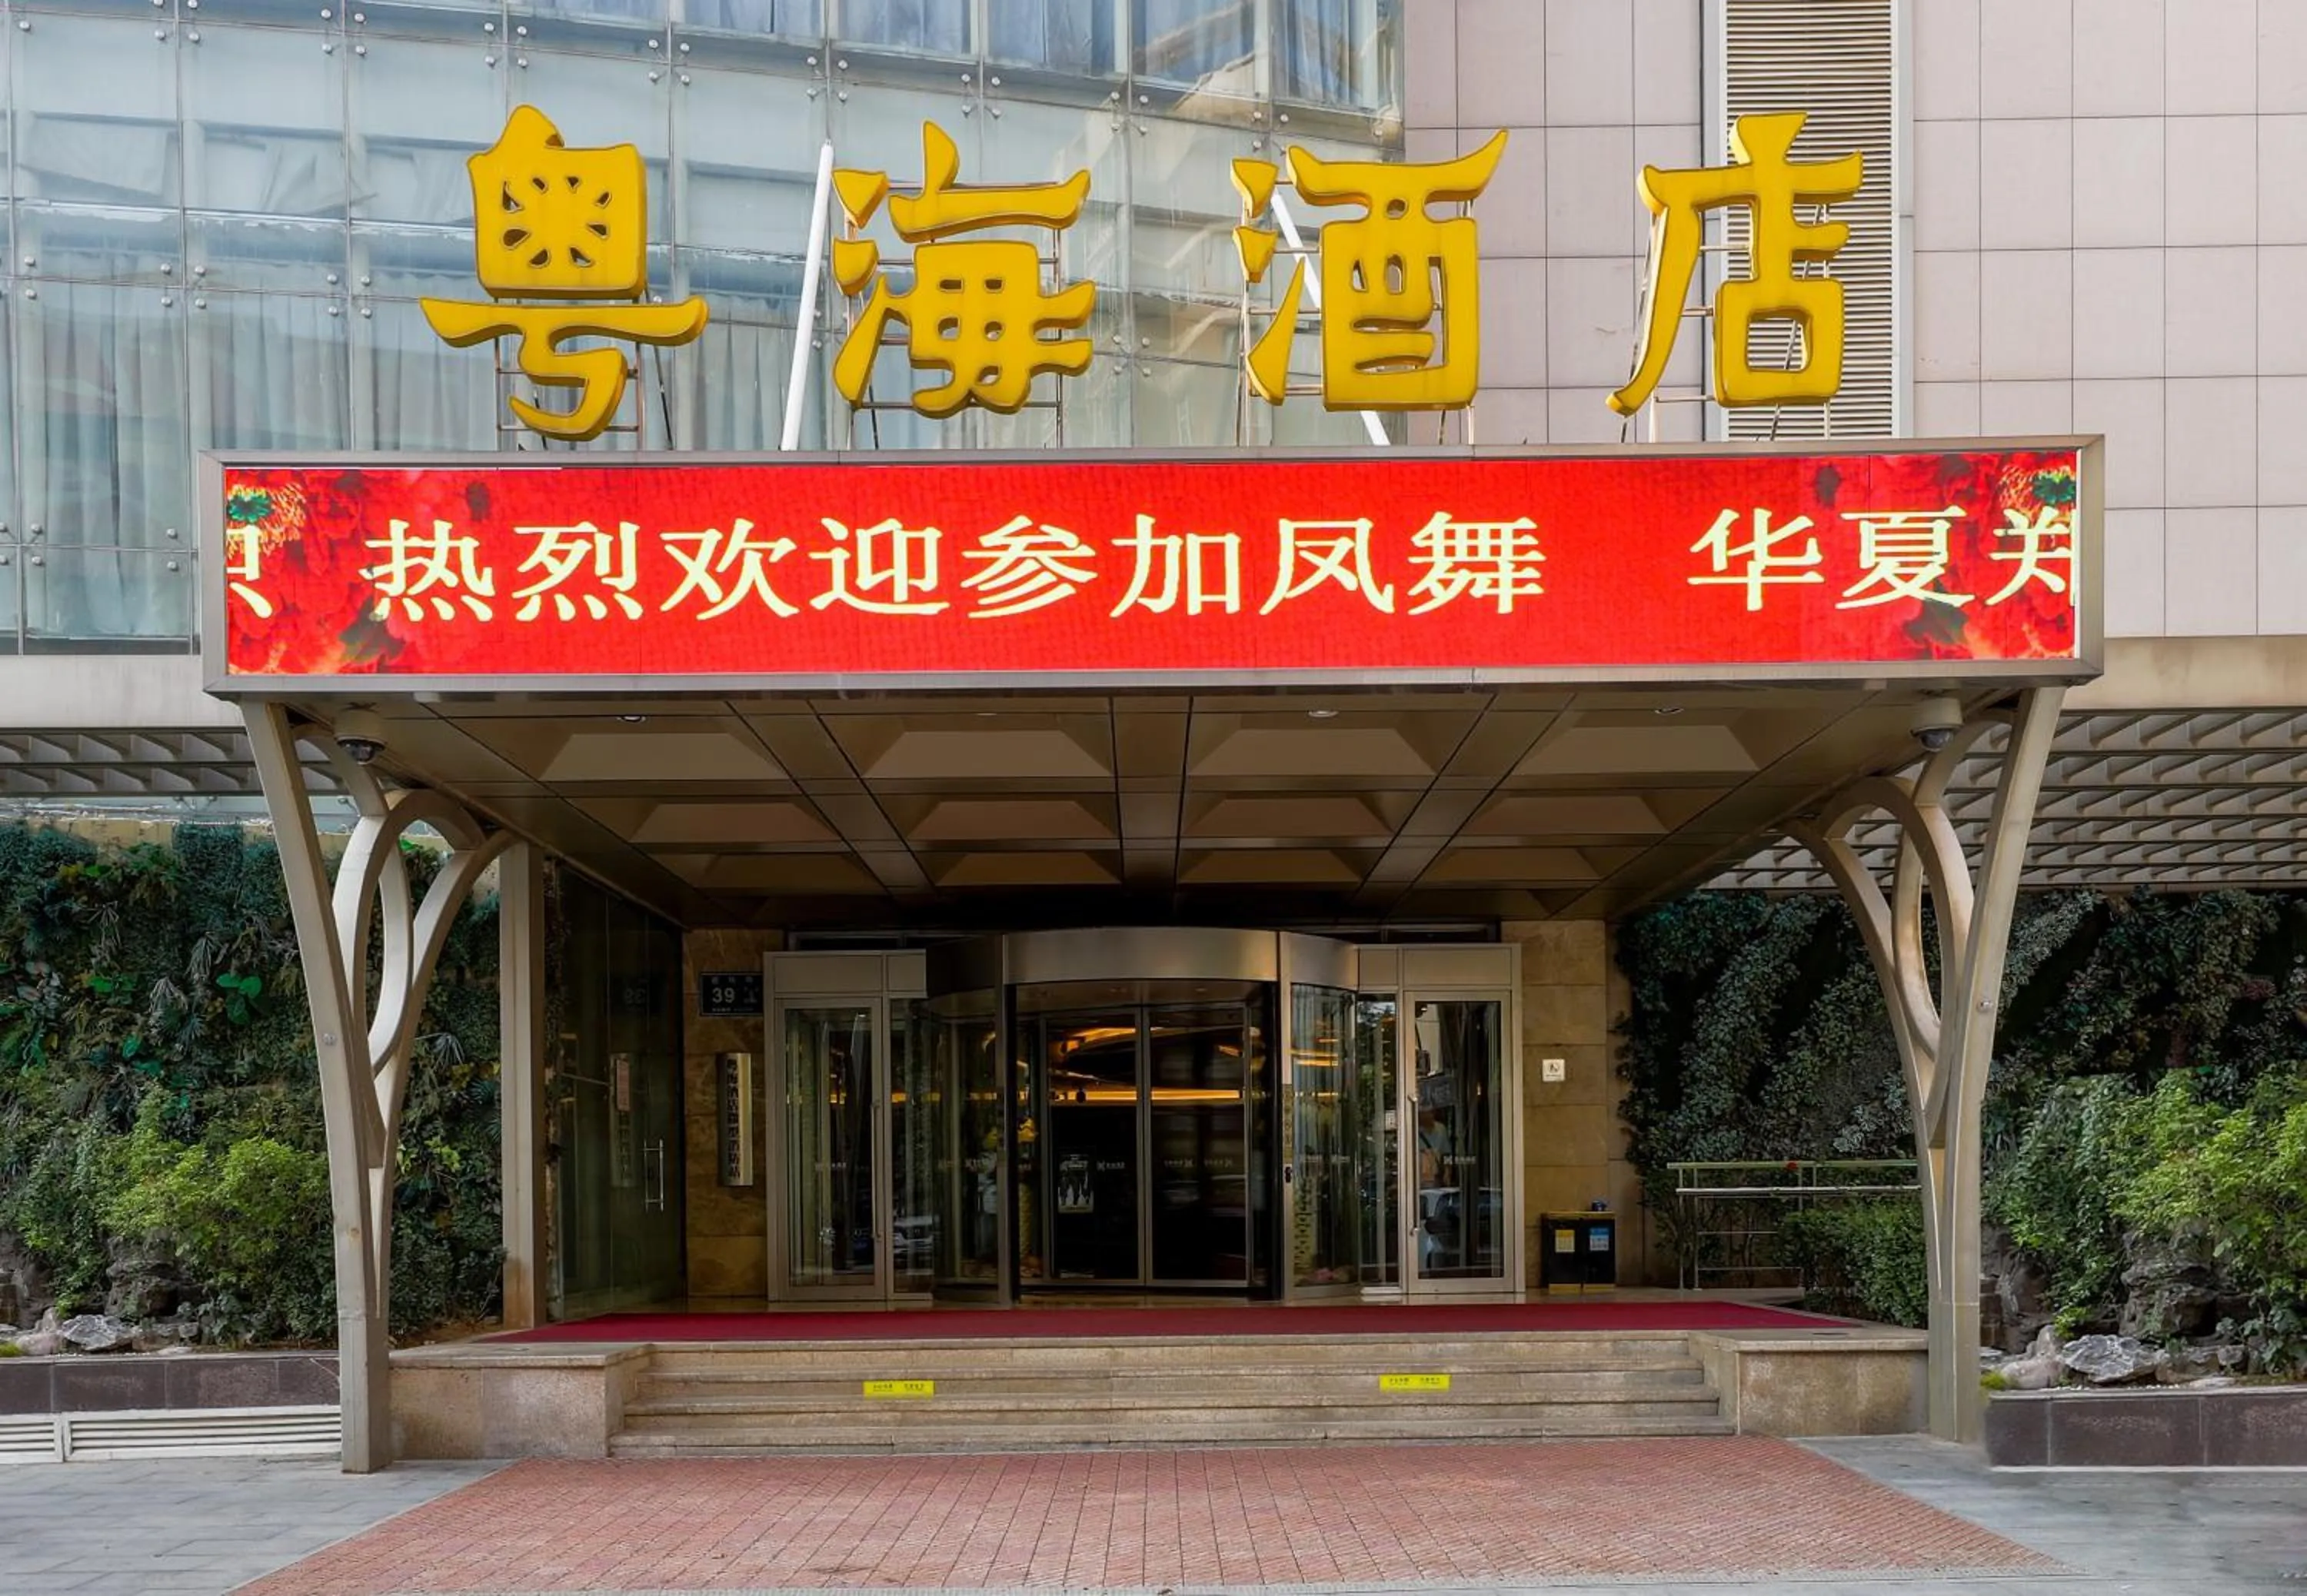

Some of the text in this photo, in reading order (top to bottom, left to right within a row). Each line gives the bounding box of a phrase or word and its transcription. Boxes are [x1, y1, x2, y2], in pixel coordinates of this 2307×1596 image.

[421, 105, 1869, 441] 粤海酒店
[358, 514, 1546, 621] 热烈欢迎参加凤舞
